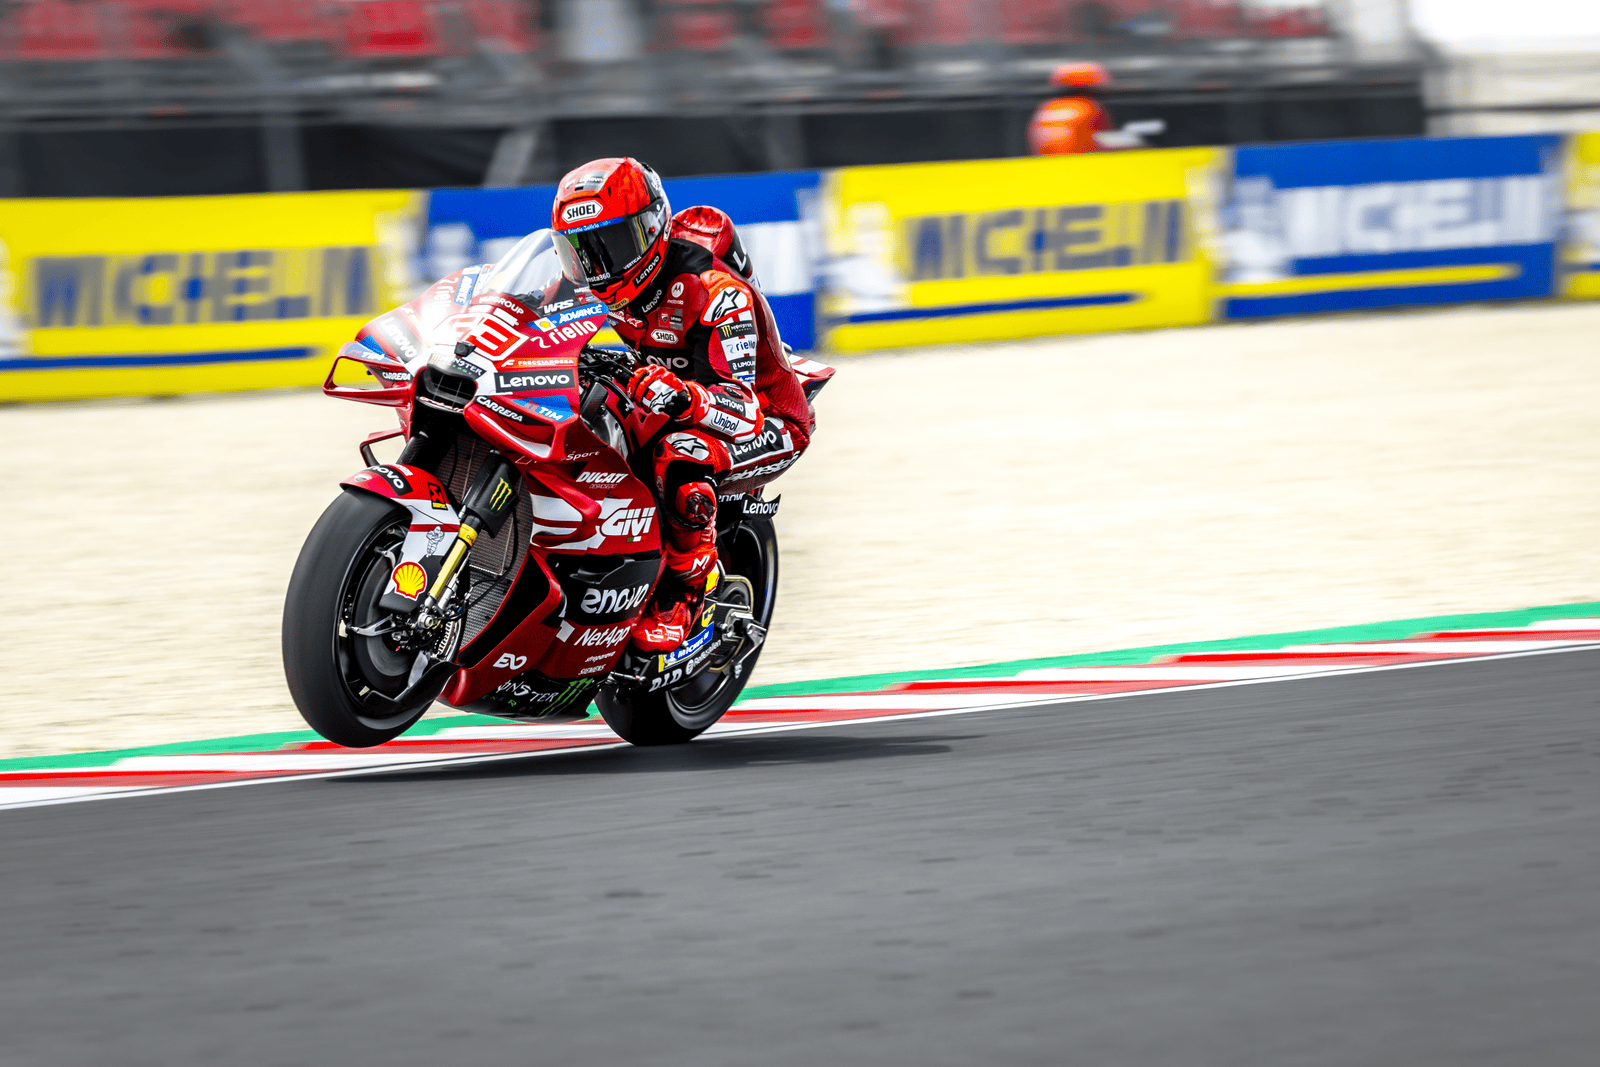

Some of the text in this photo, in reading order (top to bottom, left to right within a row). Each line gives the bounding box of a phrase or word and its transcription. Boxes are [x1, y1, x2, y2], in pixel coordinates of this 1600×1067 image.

[566, 204, 596, 220] SHOEI
[586, 272, 611, 282] nsta360
[635, 255, 660, 284] Lenovo
[543, 299, 574, 314] WRS
[641, 289, 662, 313] Lenovo
[558, 304, 603, 323] ADVANCE
[548, 320, 598, 345] riello
[655, 331, 676, 342] SHOEI
[381, 371, 411, 381] CARRERA
[498, 374, 571, 388] Lenovo
[476, 396, 523, 422] CARRERA
[715, 395, 744, 413] Lenovo
[538, 406, 564, 421] TIM
[713, 411, 740, 432] Unipol
[565, 450, 601, 462] Sport
[575, 471, 629, 483] DUCATI
[742, 499, 779, 515] Lenovo
[601, 506, 656, 537] GIVI
[578, 583, 650, 615] enovo
[573, 626, 632, 648] NetApp
[495, 679, 560, 703] ONSTER
